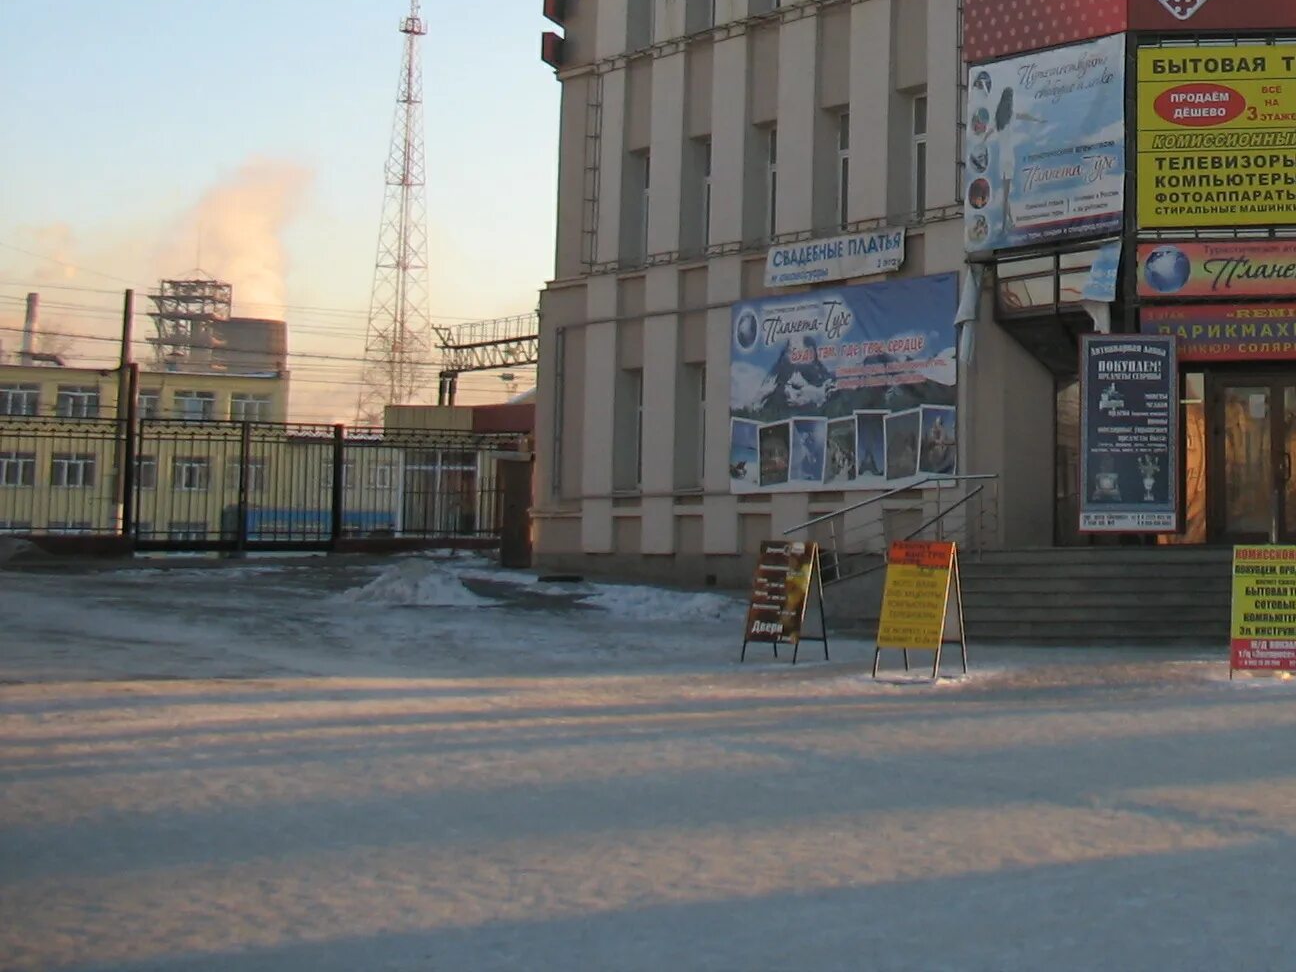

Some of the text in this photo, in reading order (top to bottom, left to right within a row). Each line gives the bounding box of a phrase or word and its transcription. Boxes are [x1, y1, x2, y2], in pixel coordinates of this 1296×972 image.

[1152, 56, 1267, 75] БЫТОВАЯ
[1264, 98, 1279, 107] НА
[1246, 106, 1259, 121] 3
[1154, 204, 1237, 215] СТИРАЛЬНЫЕ
[773, 231, 902, 268] СВАДЕБНЫЕ ПЛАТЬЯ
[1098, 361, 1162, 373] ПОКУПАЕМ!
[1254, 600, 1296, 609] СОТОВЫЕ
[751, 620, 784, 635] Двери
